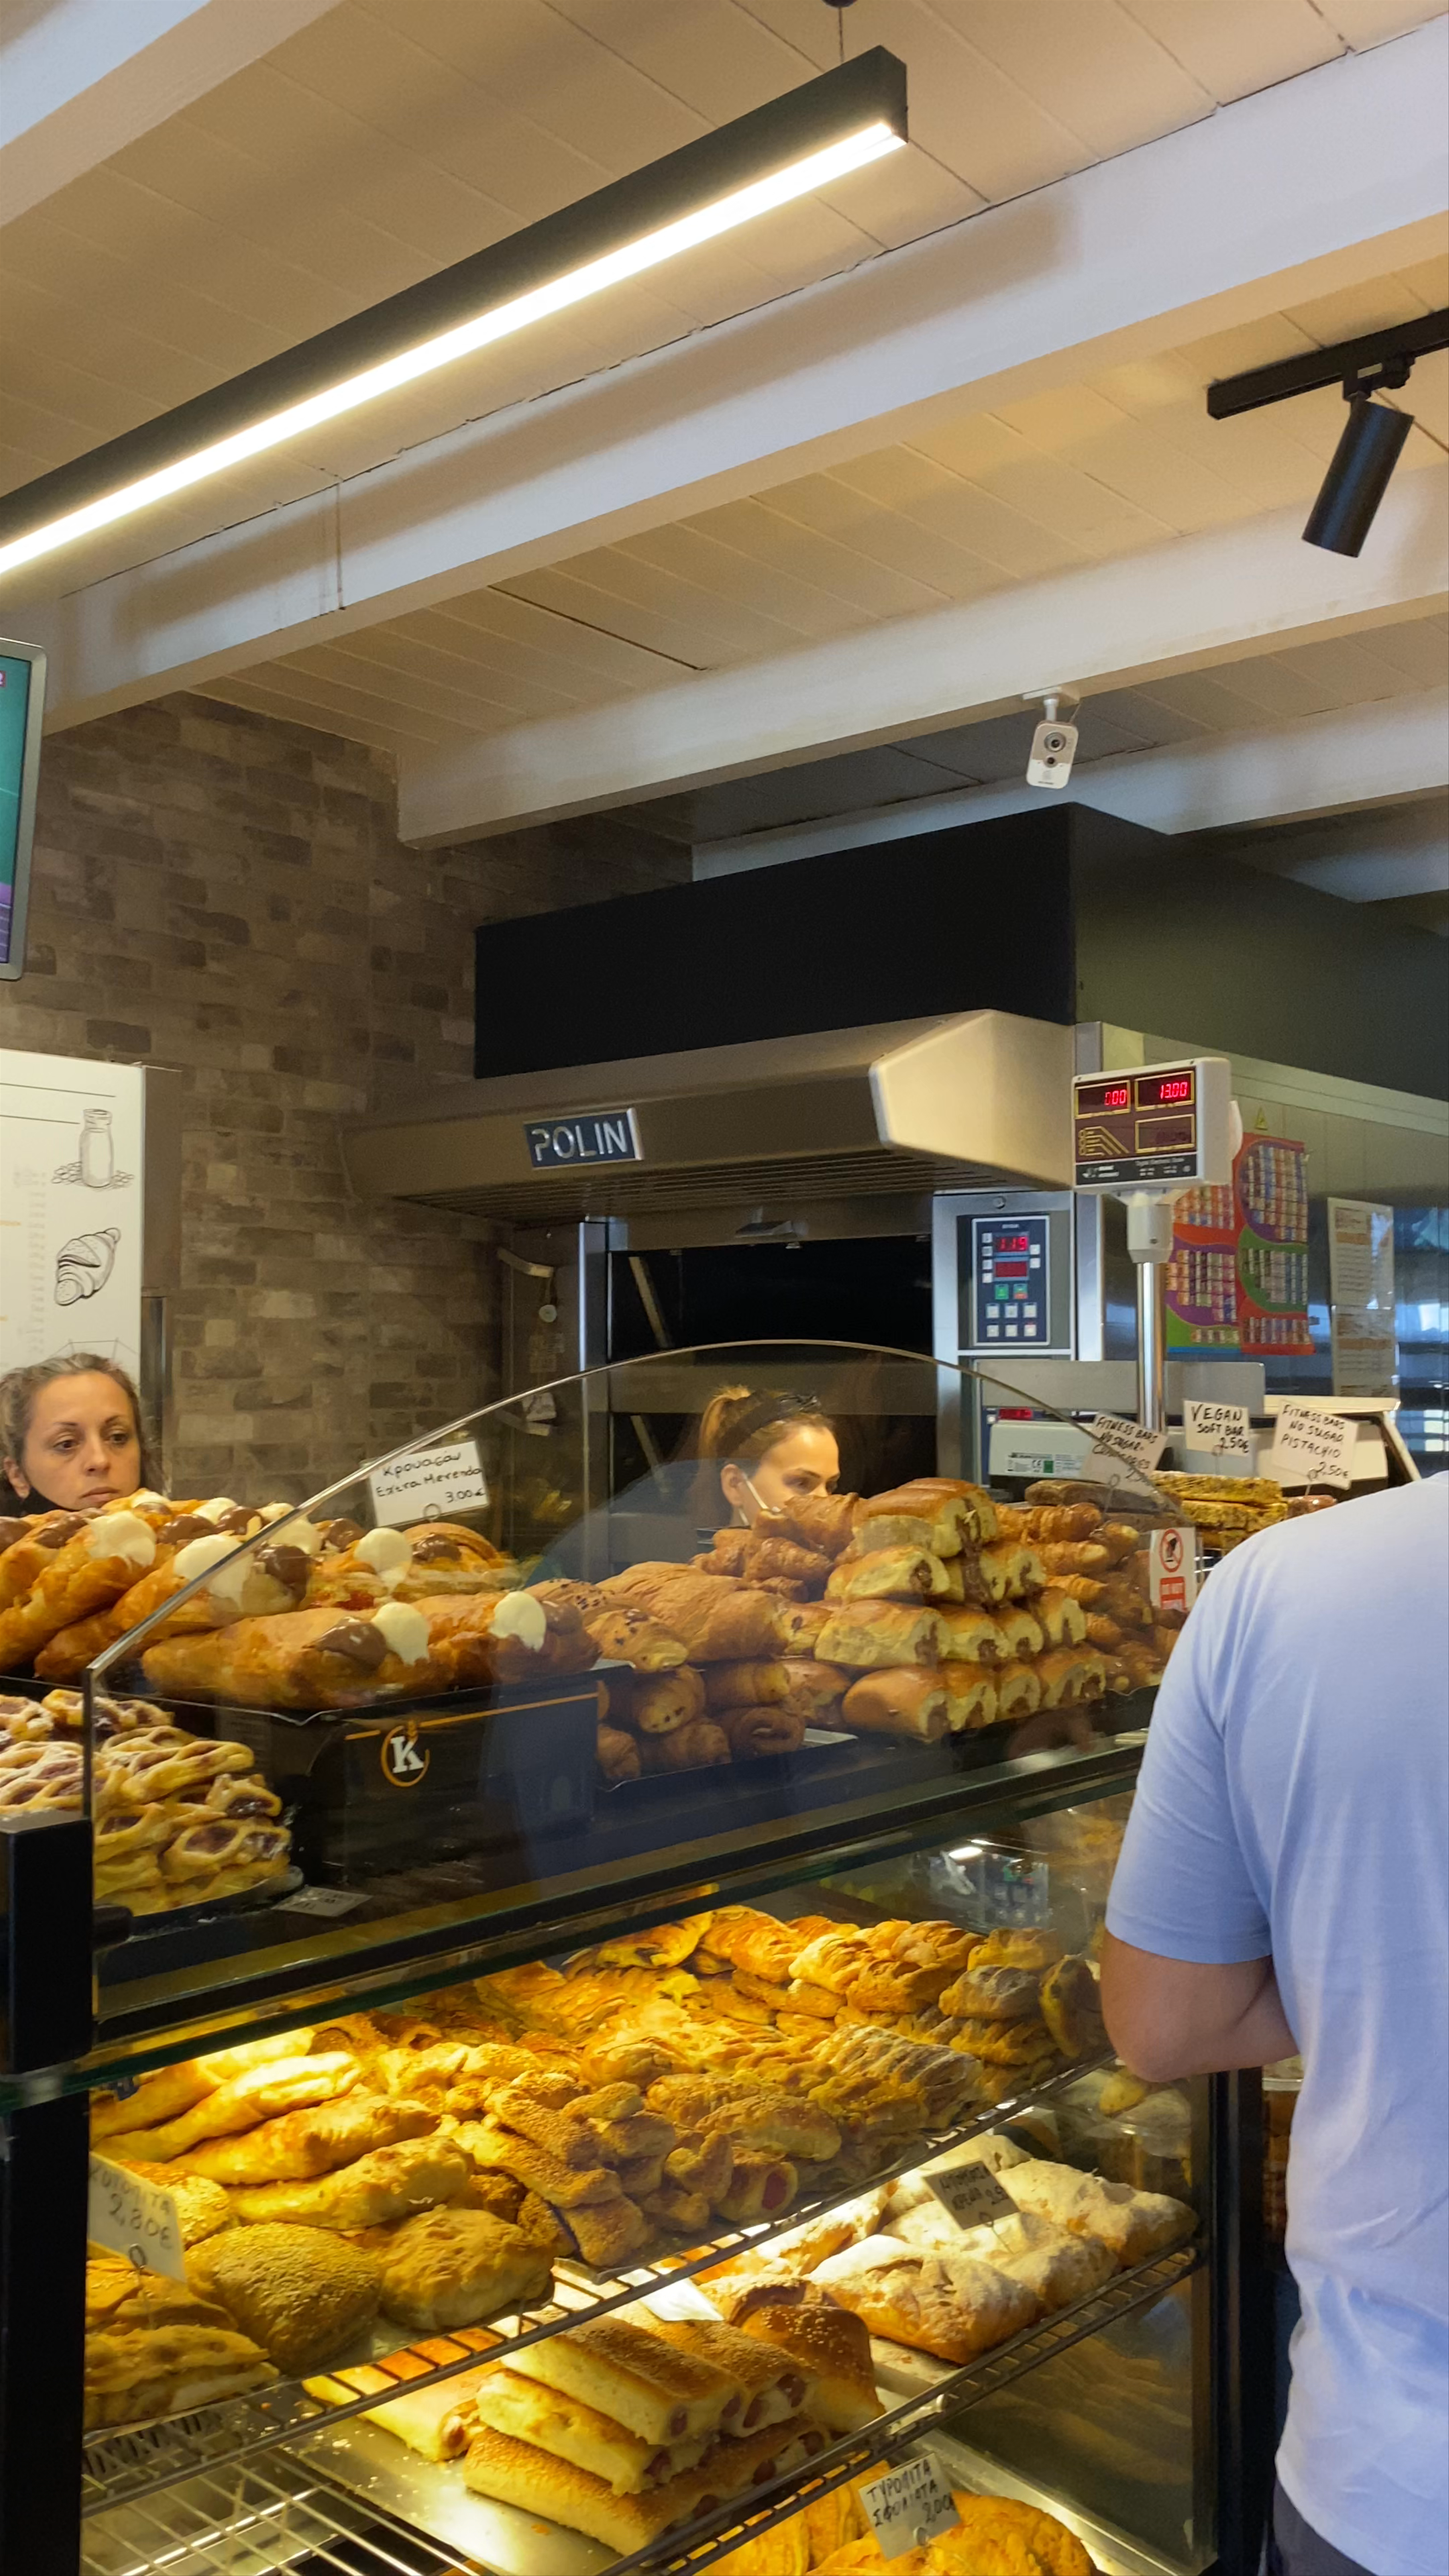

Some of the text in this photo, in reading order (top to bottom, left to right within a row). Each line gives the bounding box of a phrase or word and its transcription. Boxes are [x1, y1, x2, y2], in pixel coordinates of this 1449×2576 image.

[531, 1120, 628, 1161] POLIN
[1191, 1404, 1242, 1421] VEGAN
[1283, 1404, 1321, 1423] FITNESS
[1197, 1423, 1244, 1436] SOFT BAR
[1289, 1421, 1344, 1444] NO SUGAR
[1281, 1433, 1341, 1458] PISTACHIO
[390, 1736, 424, 1773] K
